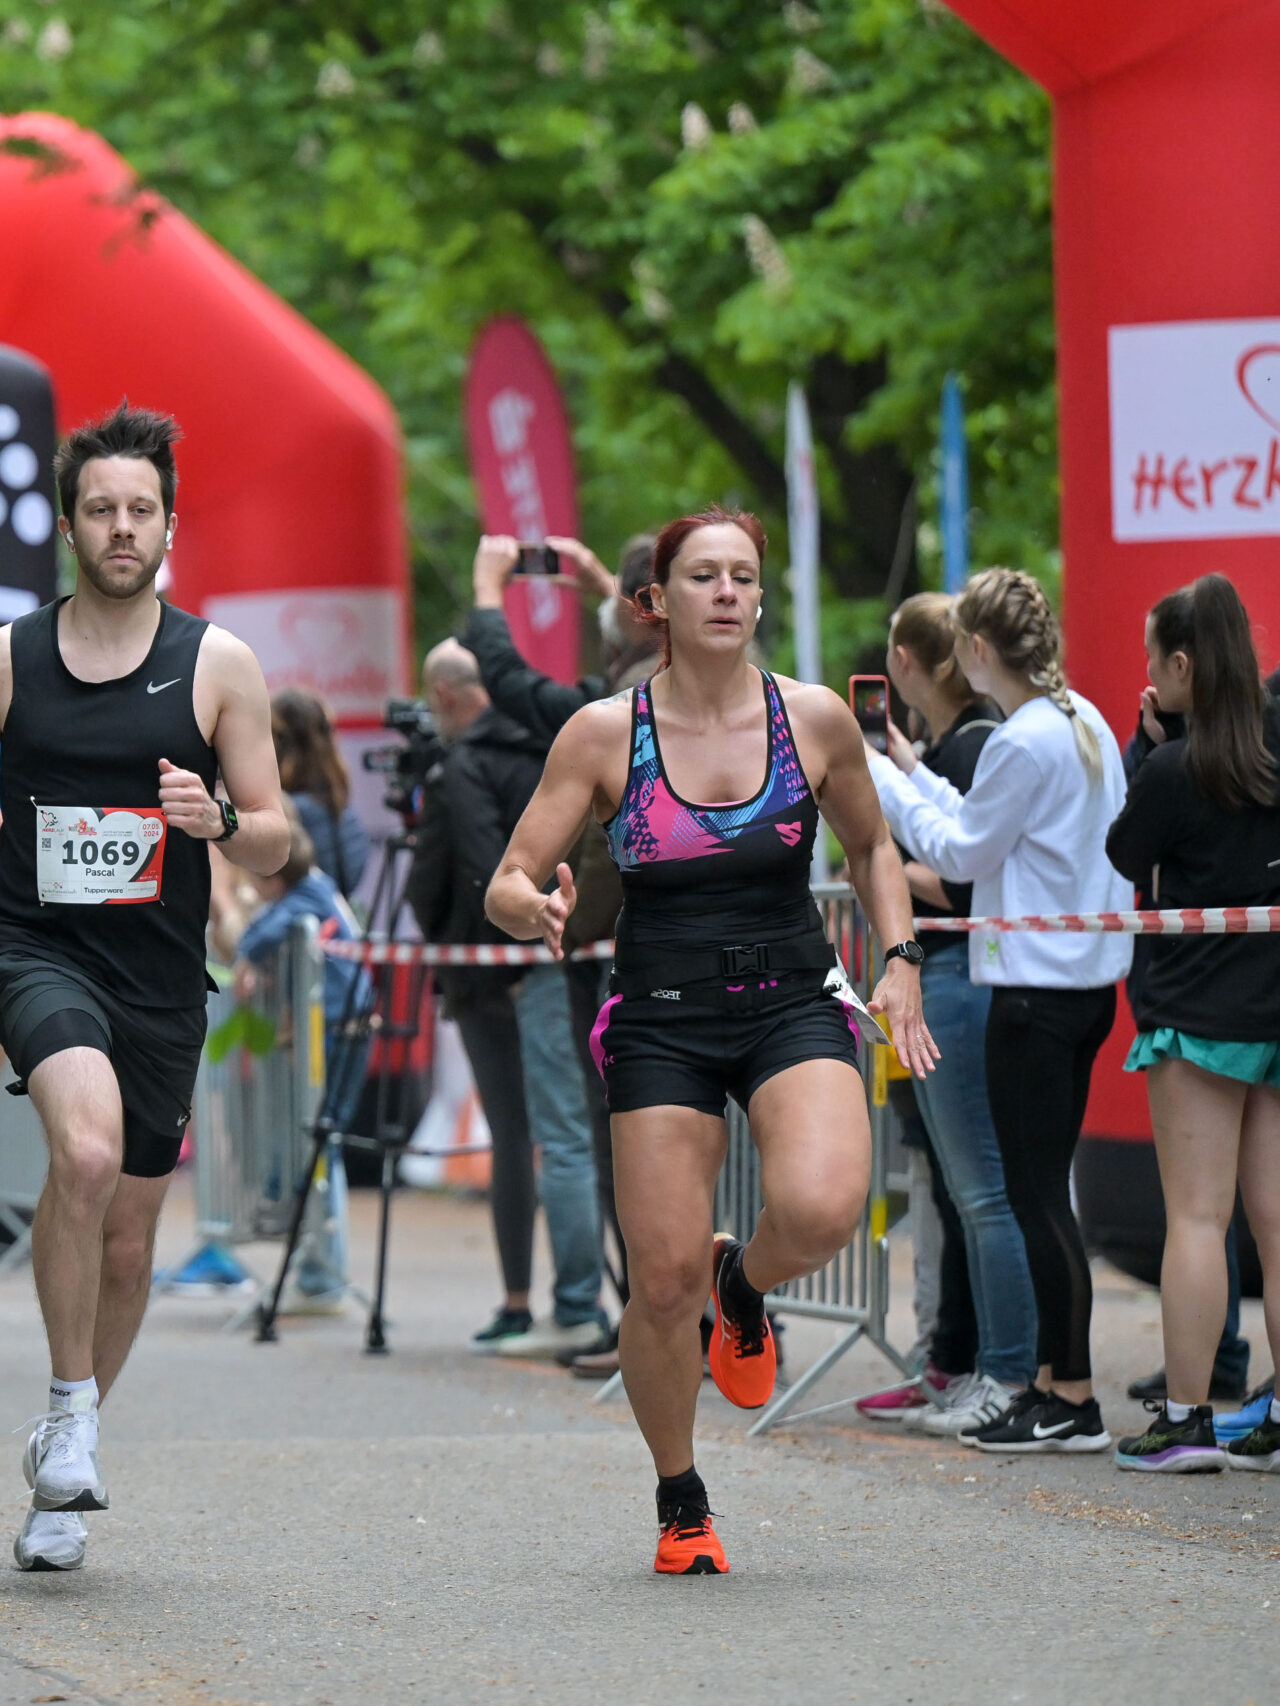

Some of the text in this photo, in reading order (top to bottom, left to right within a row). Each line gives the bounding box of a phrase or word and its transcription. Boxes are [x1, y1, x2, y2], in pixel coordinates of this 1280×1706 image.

[62, 840, 140, 866] 1069
[85, 868, 115, 877] Pascal
[84, 887, 124, 895] Tupperware
